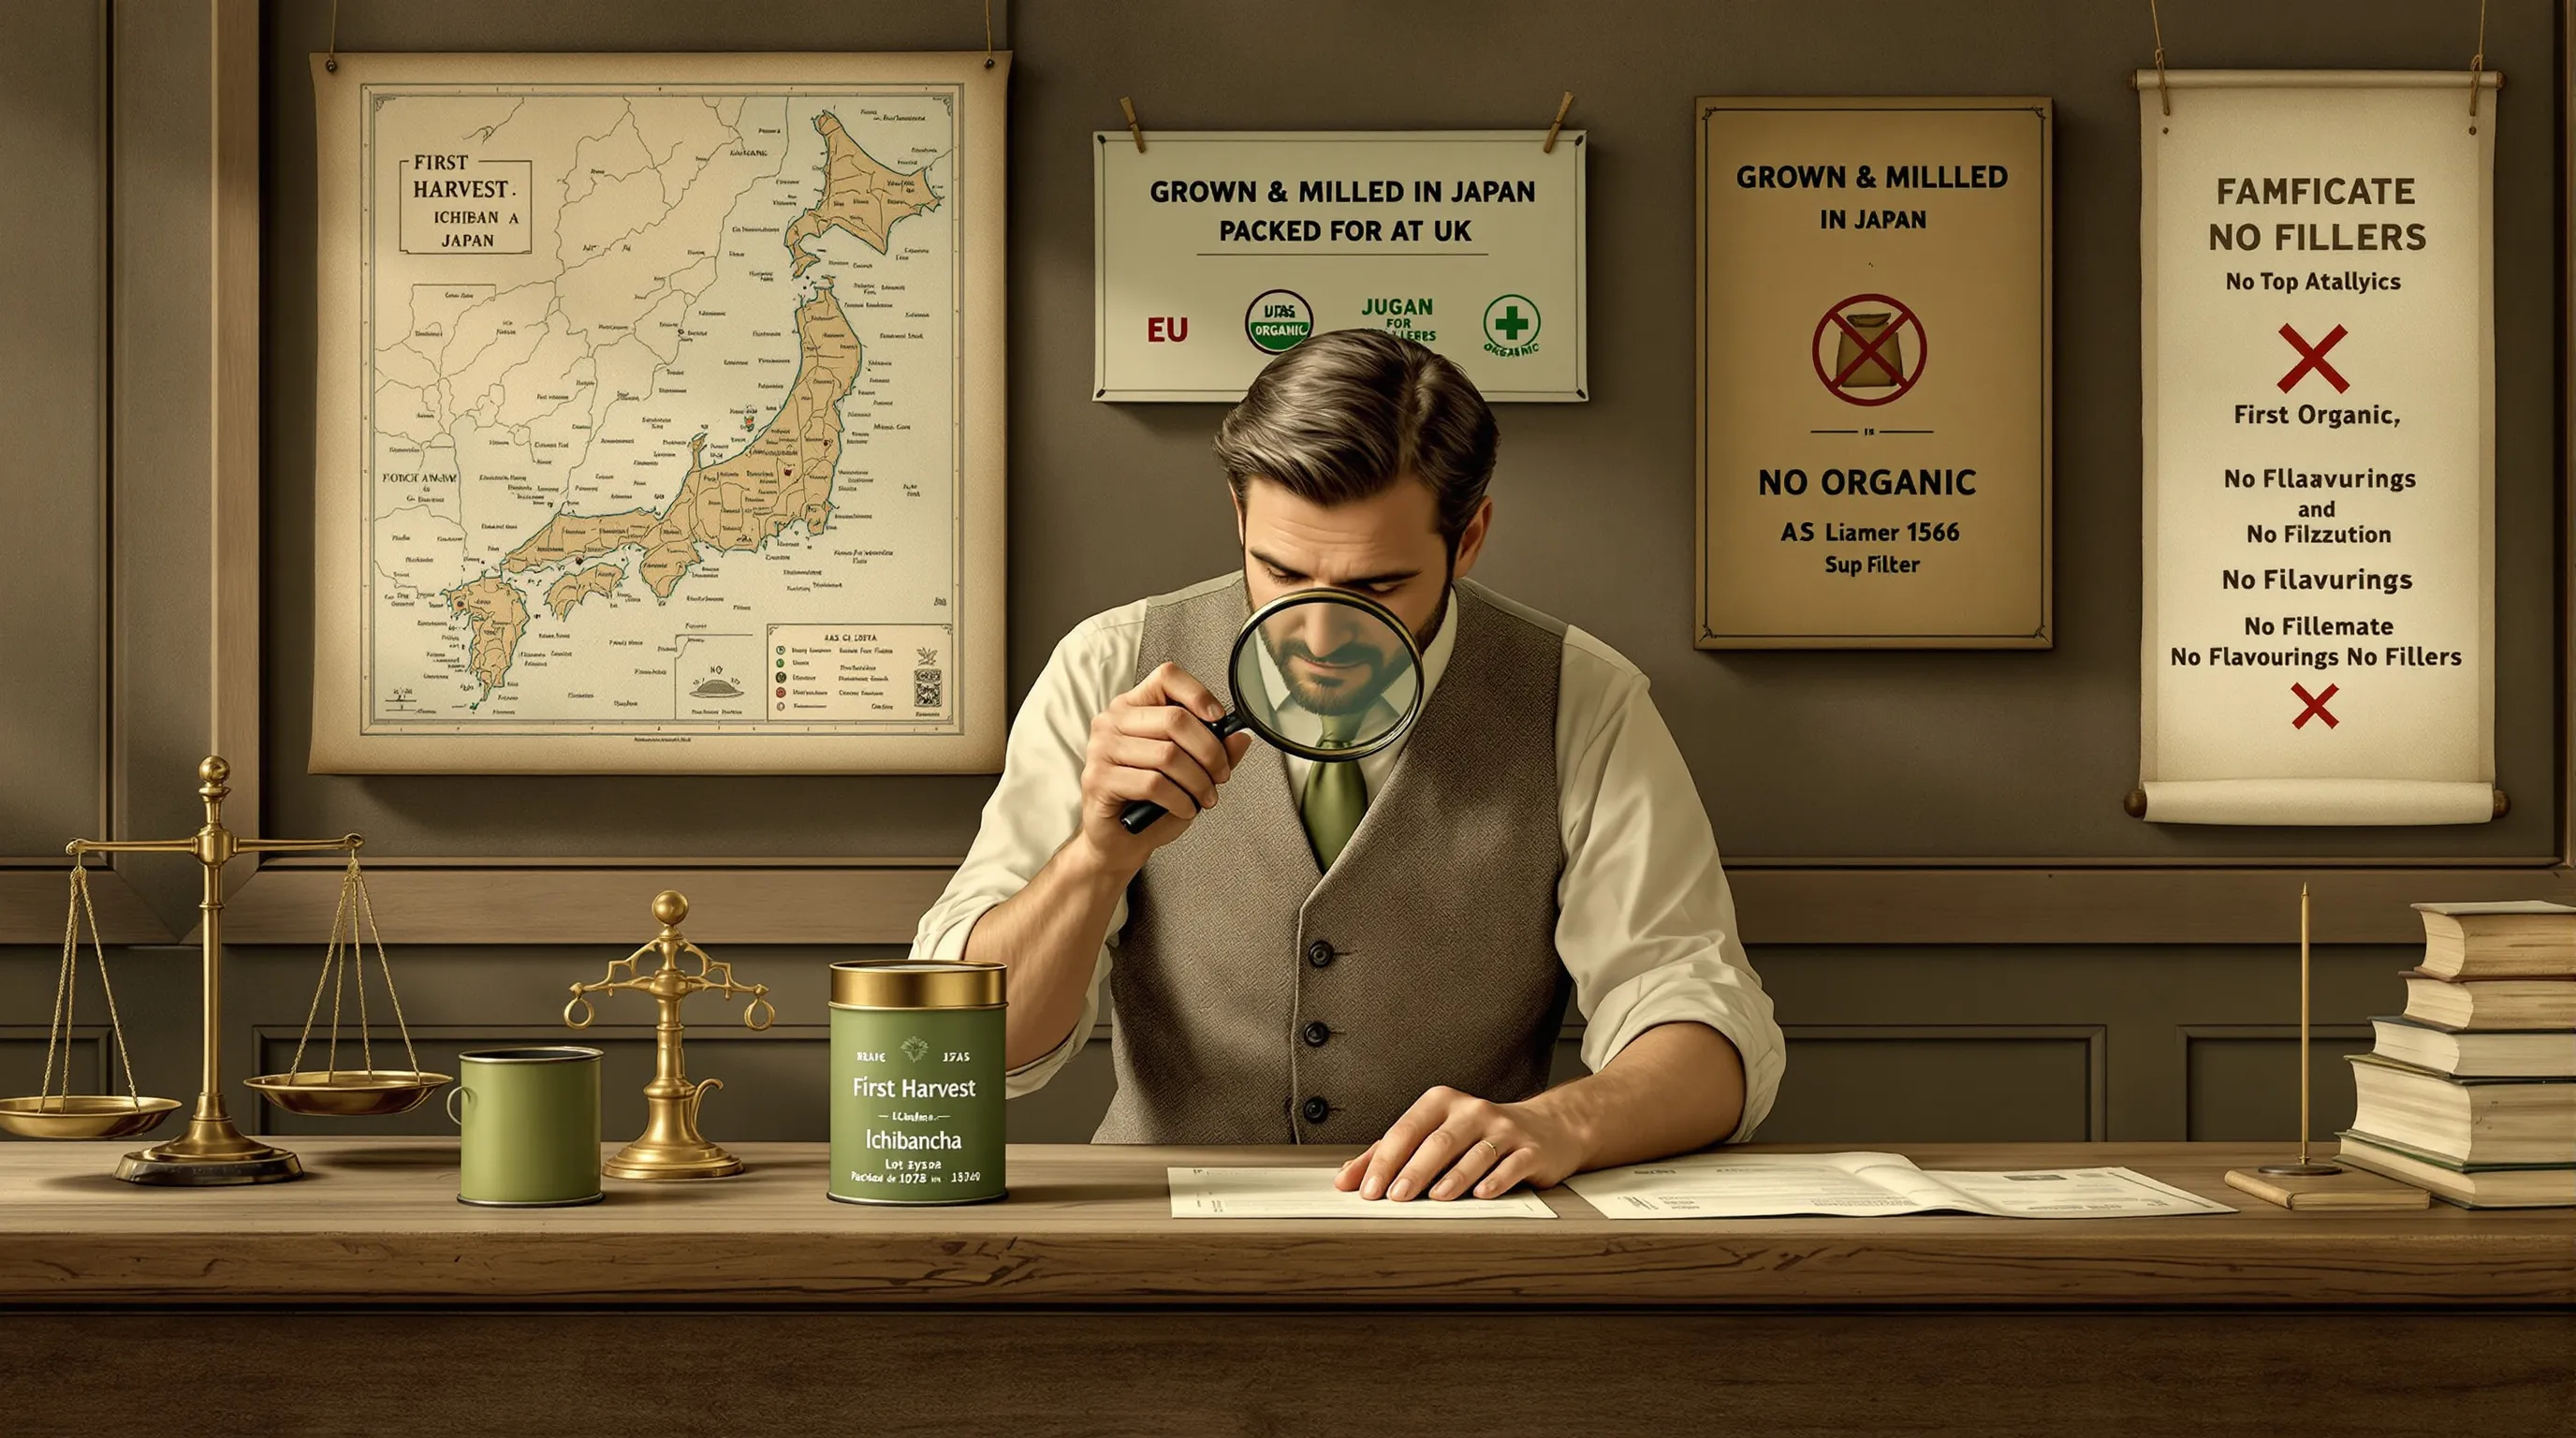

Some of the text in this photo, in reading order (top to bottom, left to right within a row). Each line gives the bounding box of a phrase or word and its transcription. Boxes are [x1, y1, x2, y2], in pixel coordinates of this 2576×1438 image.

[416, 154, 468, 169] FIRST
[1737, 165, 2008, 188] GROWN & MILLLED
[1151, 181, 1534, 202] GROWN & MILLED IN JAPAN
[2218, 178, 2415, 204] FAMFICATE
[435, 211, 518, 224] ICHIBAN A
[1822, 210, 1925, 228] IN JAPAN
[442, 235, 493, 247] JAPAN
[1221, 220, 1471, 242] PACKED FOR AT UK
[2210, 224, 2426, 251] NO FILLERS
[2227, 271, 2401, 294] No Top Atallyics
[1362, 299, 1432, 315] JUGAN
[1149, 317, 1188, 342] EU
[1255, 325, 1309, 336] ORGANIC
[1386, 318, 1411, 328] FOR
[2235, 404, 2400, 429] First Organic,
[1760, 469, 1976, 495] NO ORGANIC
[2225, 469, 2255, 488] No
[2299, 501, 2334, 517] and
[1781, 522, 1959, 541] AS Liamer 1566
[2248, 525, 2391, 543] No Filzzution
[1826, 555, 1920, 577] Sup Filter
[2223, 568, 2412, 594] No Filavurings
[2246, 616, 2393, 636] No Fillemate
[2172, 646, 2462, 669] No Flavourings No Fillers
[854, 1076, 975, 1097] First Harvest
[867, 1129, 961, 1150] Ichibancha
[886, 1159, 902, 1170] Lot
